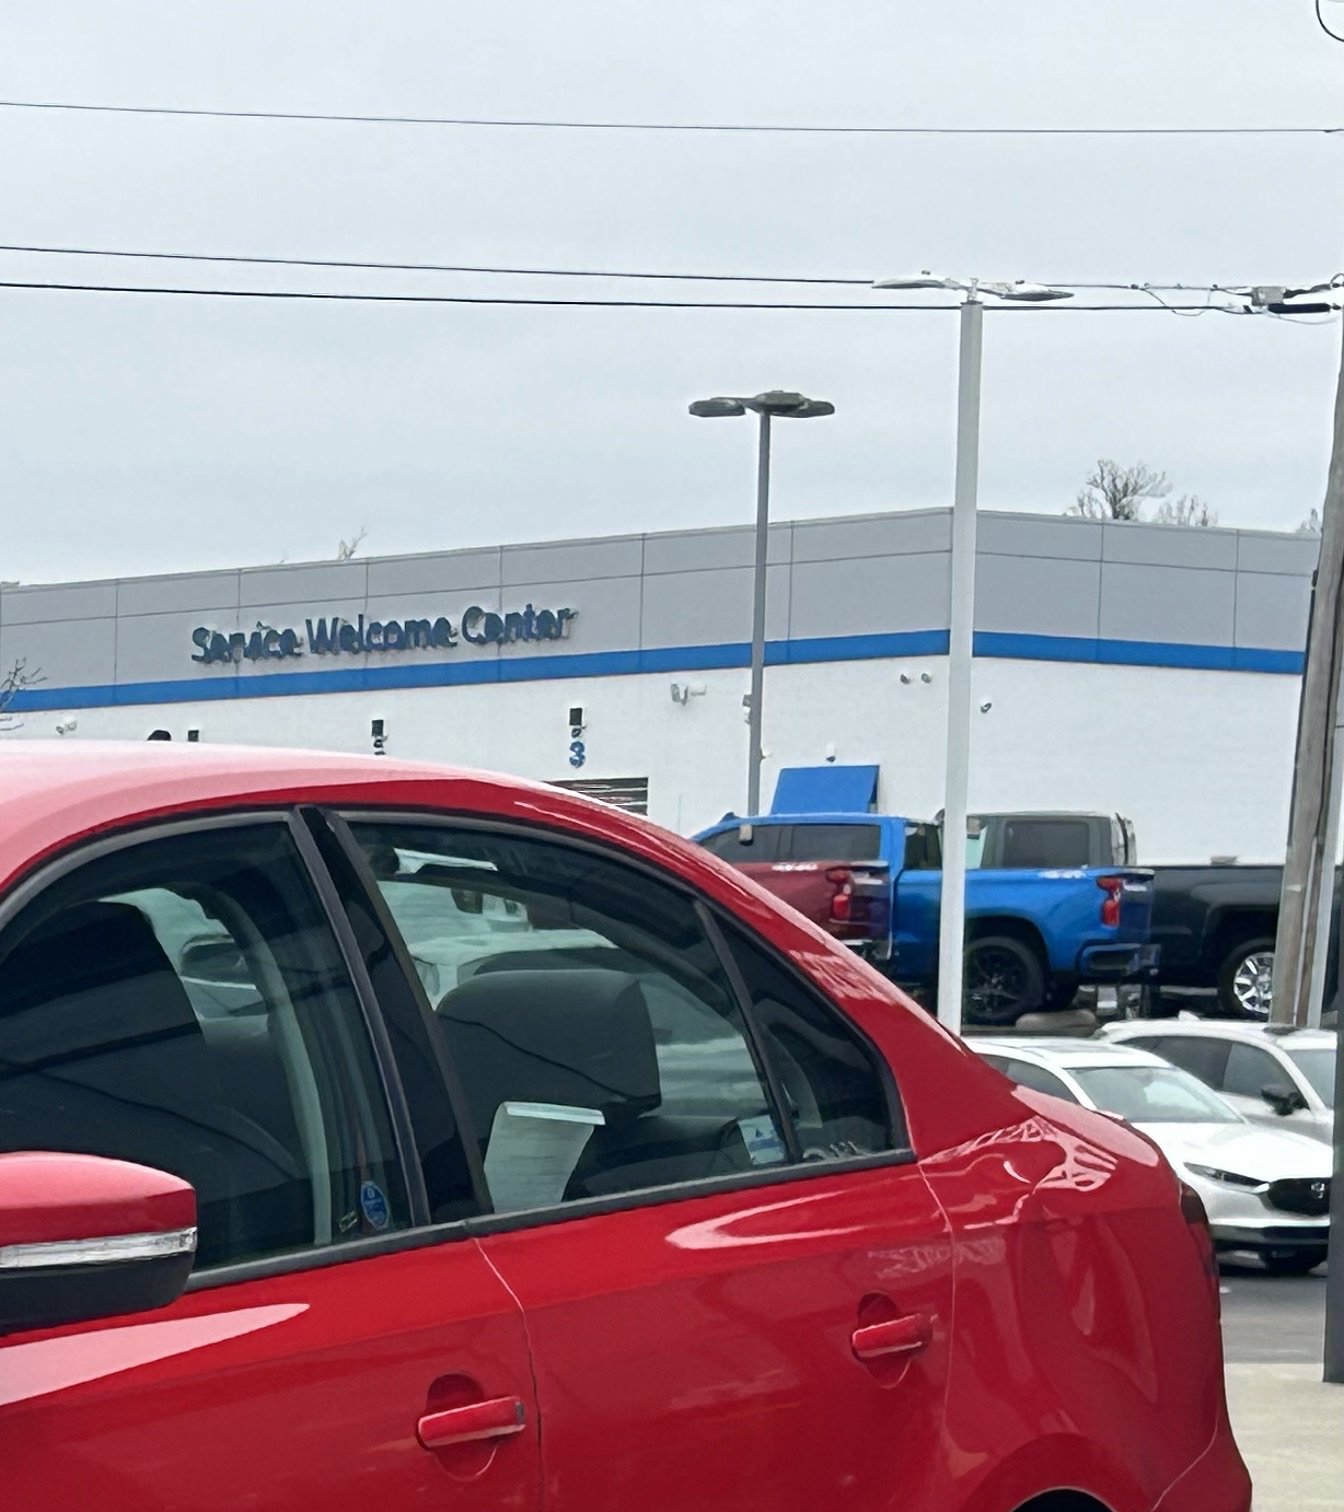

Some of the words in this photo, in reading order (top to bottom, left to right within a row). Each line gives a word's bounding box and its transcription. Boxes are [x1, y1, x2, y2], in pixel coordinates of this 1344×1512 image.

[191, 620, 303, 664] Service
[305, 611, 458, 655] Welcome
[462, 603, 578, 646] Center
[569, 740, 586, 769] 3
